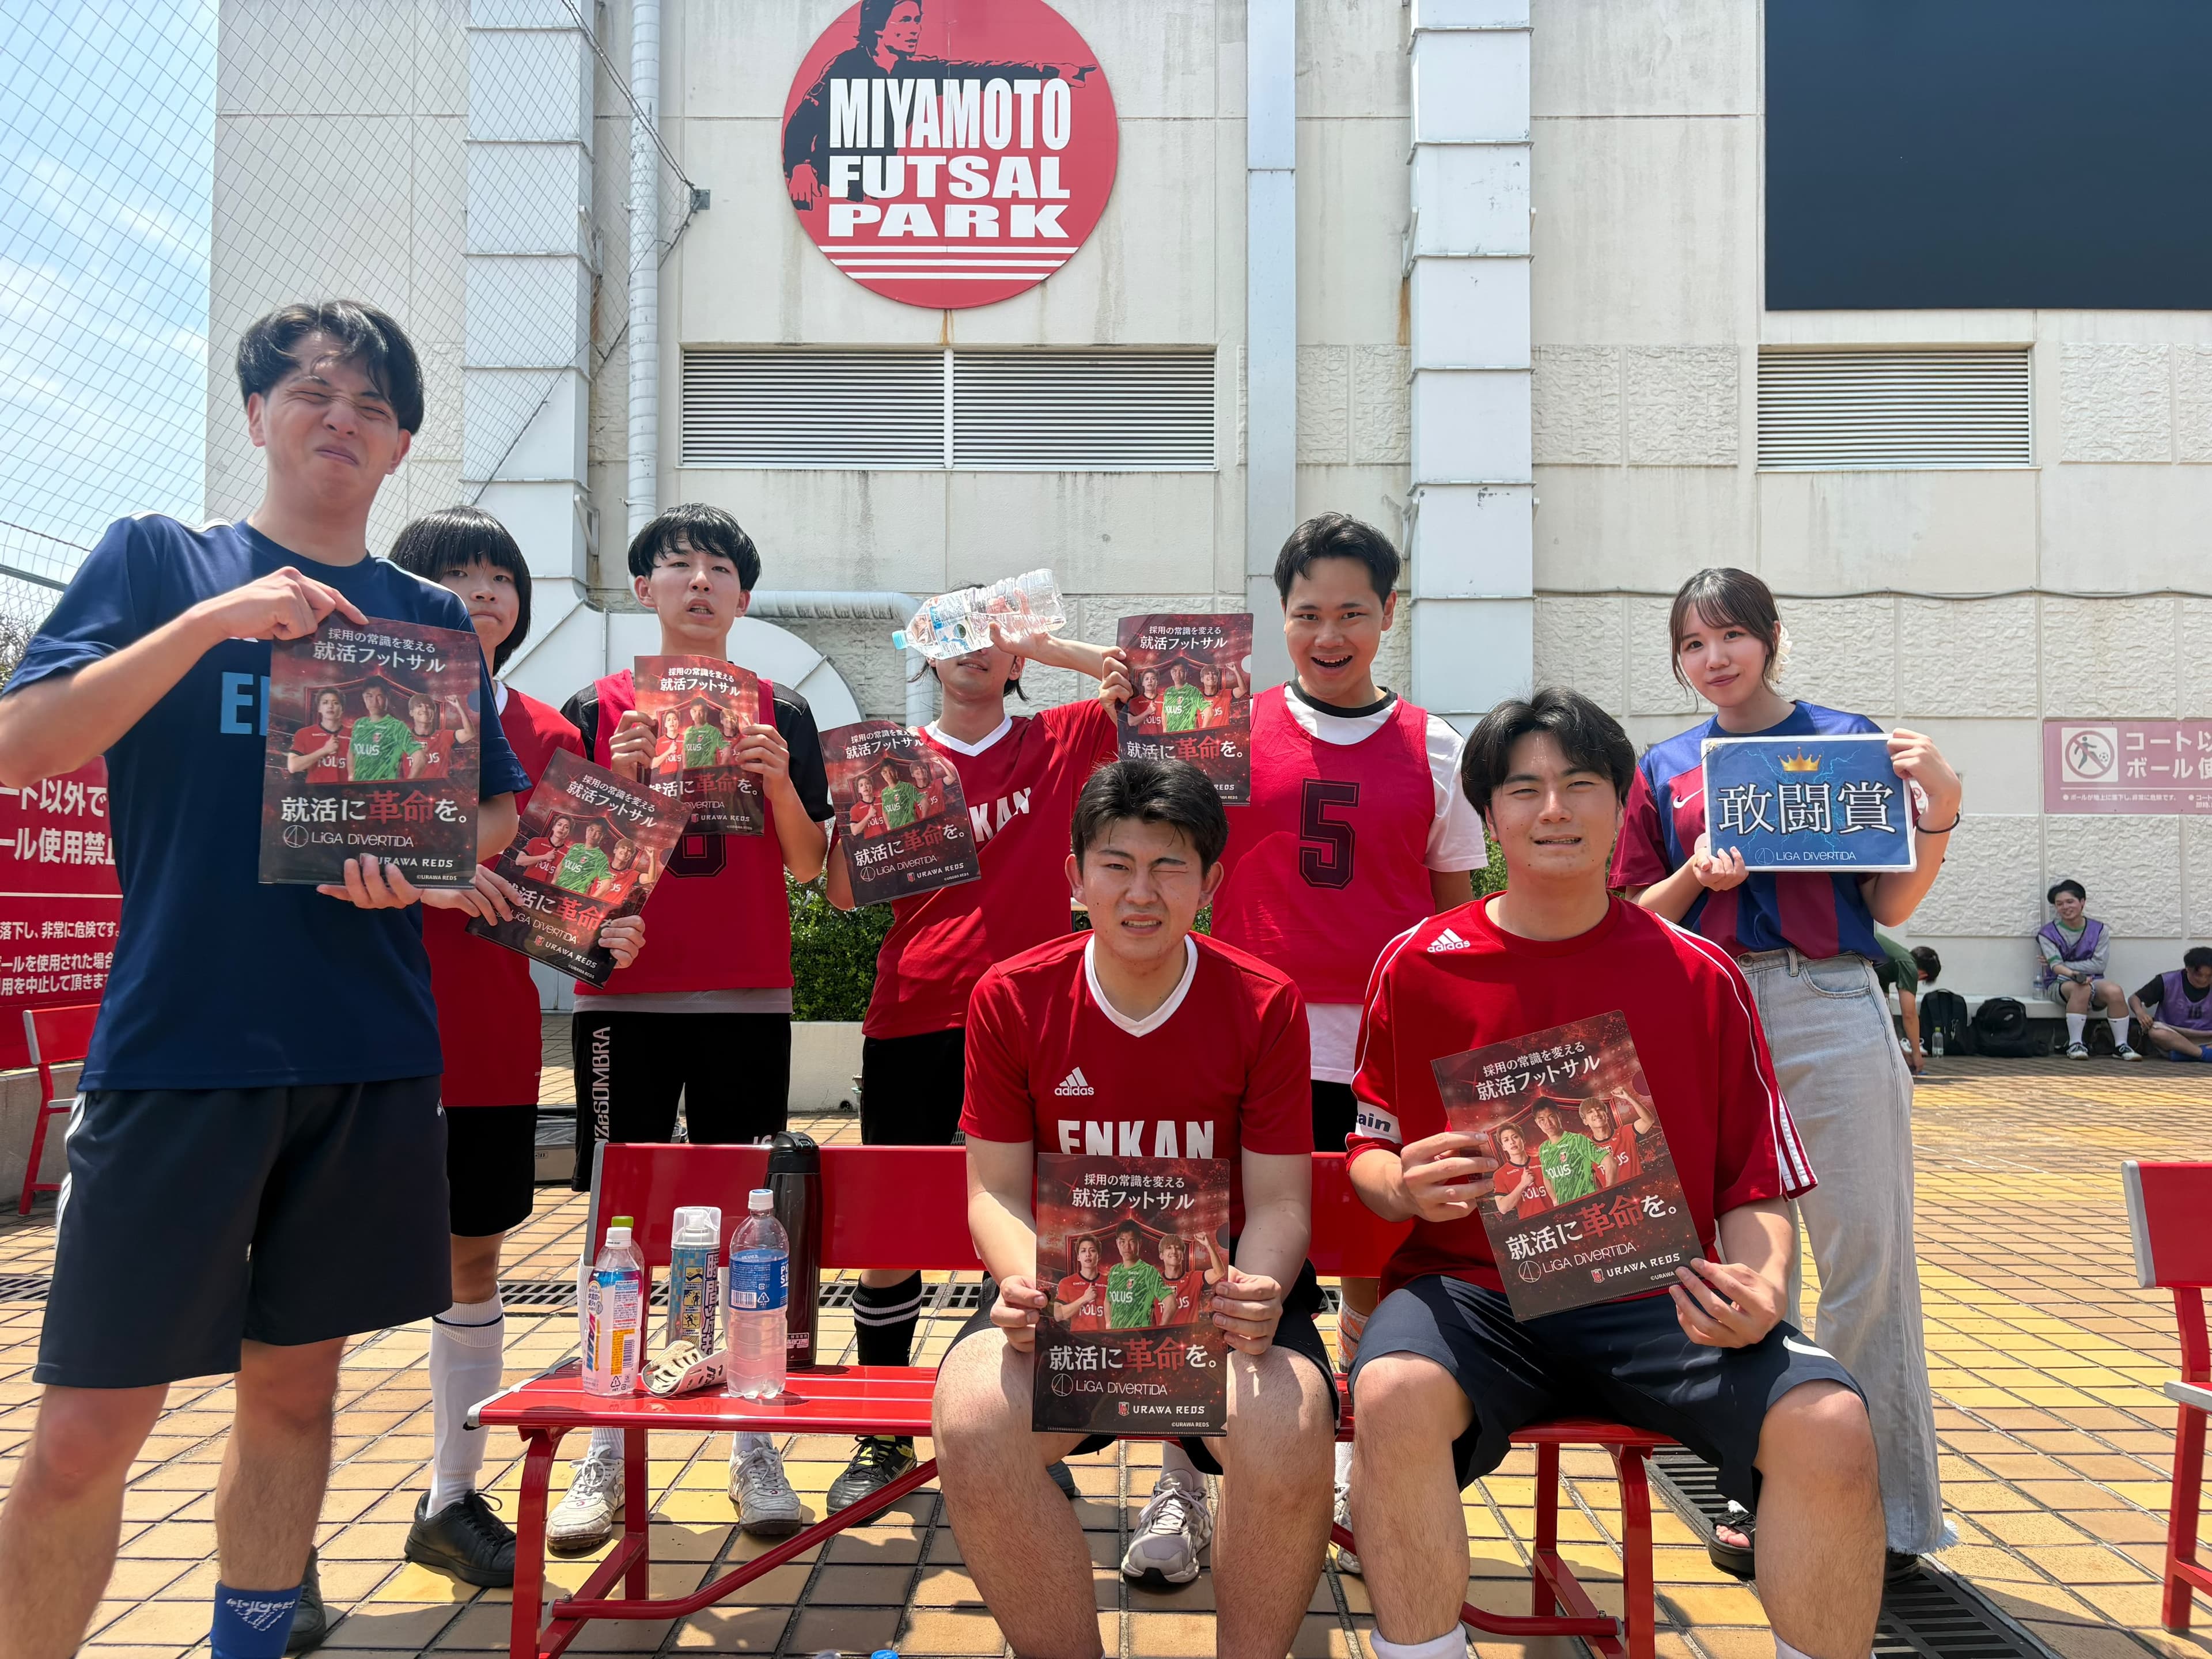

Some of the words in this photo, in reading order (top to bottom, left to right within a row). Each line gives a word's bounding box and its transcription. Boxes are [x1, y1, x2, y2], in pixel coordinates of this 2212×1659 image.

[830, 78, 1071, 150] MIYAMOTO
[829, 156, 1070, 199] FUTSAL
[828, 204, 1070, 238] PARK
[328, 627, 436, 653] 採用の常識を変える
[1139, 635, 1228, 650] 就活フットサル
[1149, 626, 1221, 635] 採用の常識を変える
[313, 641, 446, 673] 就活フットサル
[660, 677, 740, 696] 就活フットサル
[668, 667, 734, 683] 採用の常識を変える
[845, 737, 925, 759] 就活フットサル
[851, 729, 916, 744] 採用の常識を変え
[1127, 735, 1243, 761] 就活に革命を。
[566, 781, 657, 828] 就活フットサル
[582, 774, 656, 813] 採用の常識を変える
[281, 790, 467, 824] 就活に革命を。
[1717, 781, 1896, 835] 敢闘賞
[854, 824, 964, 867] 就活に革命を。
[1298, 778, 1359, 890] 5
[422, 858, 453, 868] REDS
[916, 868, 943, 878] URAWA
[945, 862, 964, 872] REDS
[0, 921, 120, 940] 落下し、非常に危険です。
[545, 941, 574, 959] URAWA
[575, 954, 598, 969] REDS
[1426, 938, 1471, 953] adidas
[0, 952, 114, 973] ールを使用された場合
[1482, 1041, 1586, 1077] 採用の常識を変える
[1054, 1086, 1094, 1096] adidas
[1475, 1055, 1601, 1101] 就活フットサル
[1357, 1112, 1391, 1132] ain
[1058, 1119, 1214, 1160] ENKAN
[1084, 1173, 1185, 1188] 採用の常識を変える
[1071, 1187, 1195, 1210] 就活フットサル
[1505, 1194, 1677, 1261] 就活に革命を。
[1606, 1261, 1647, 1278] URAWA
[1650, 1252, 1681, 1267] REDS
[1048, 1336, 1217, 1373] 就活に革命を。
[1132, 1404, 1172, 1415] URAWA
[1175, 1404, 1206, 1415] REDS
